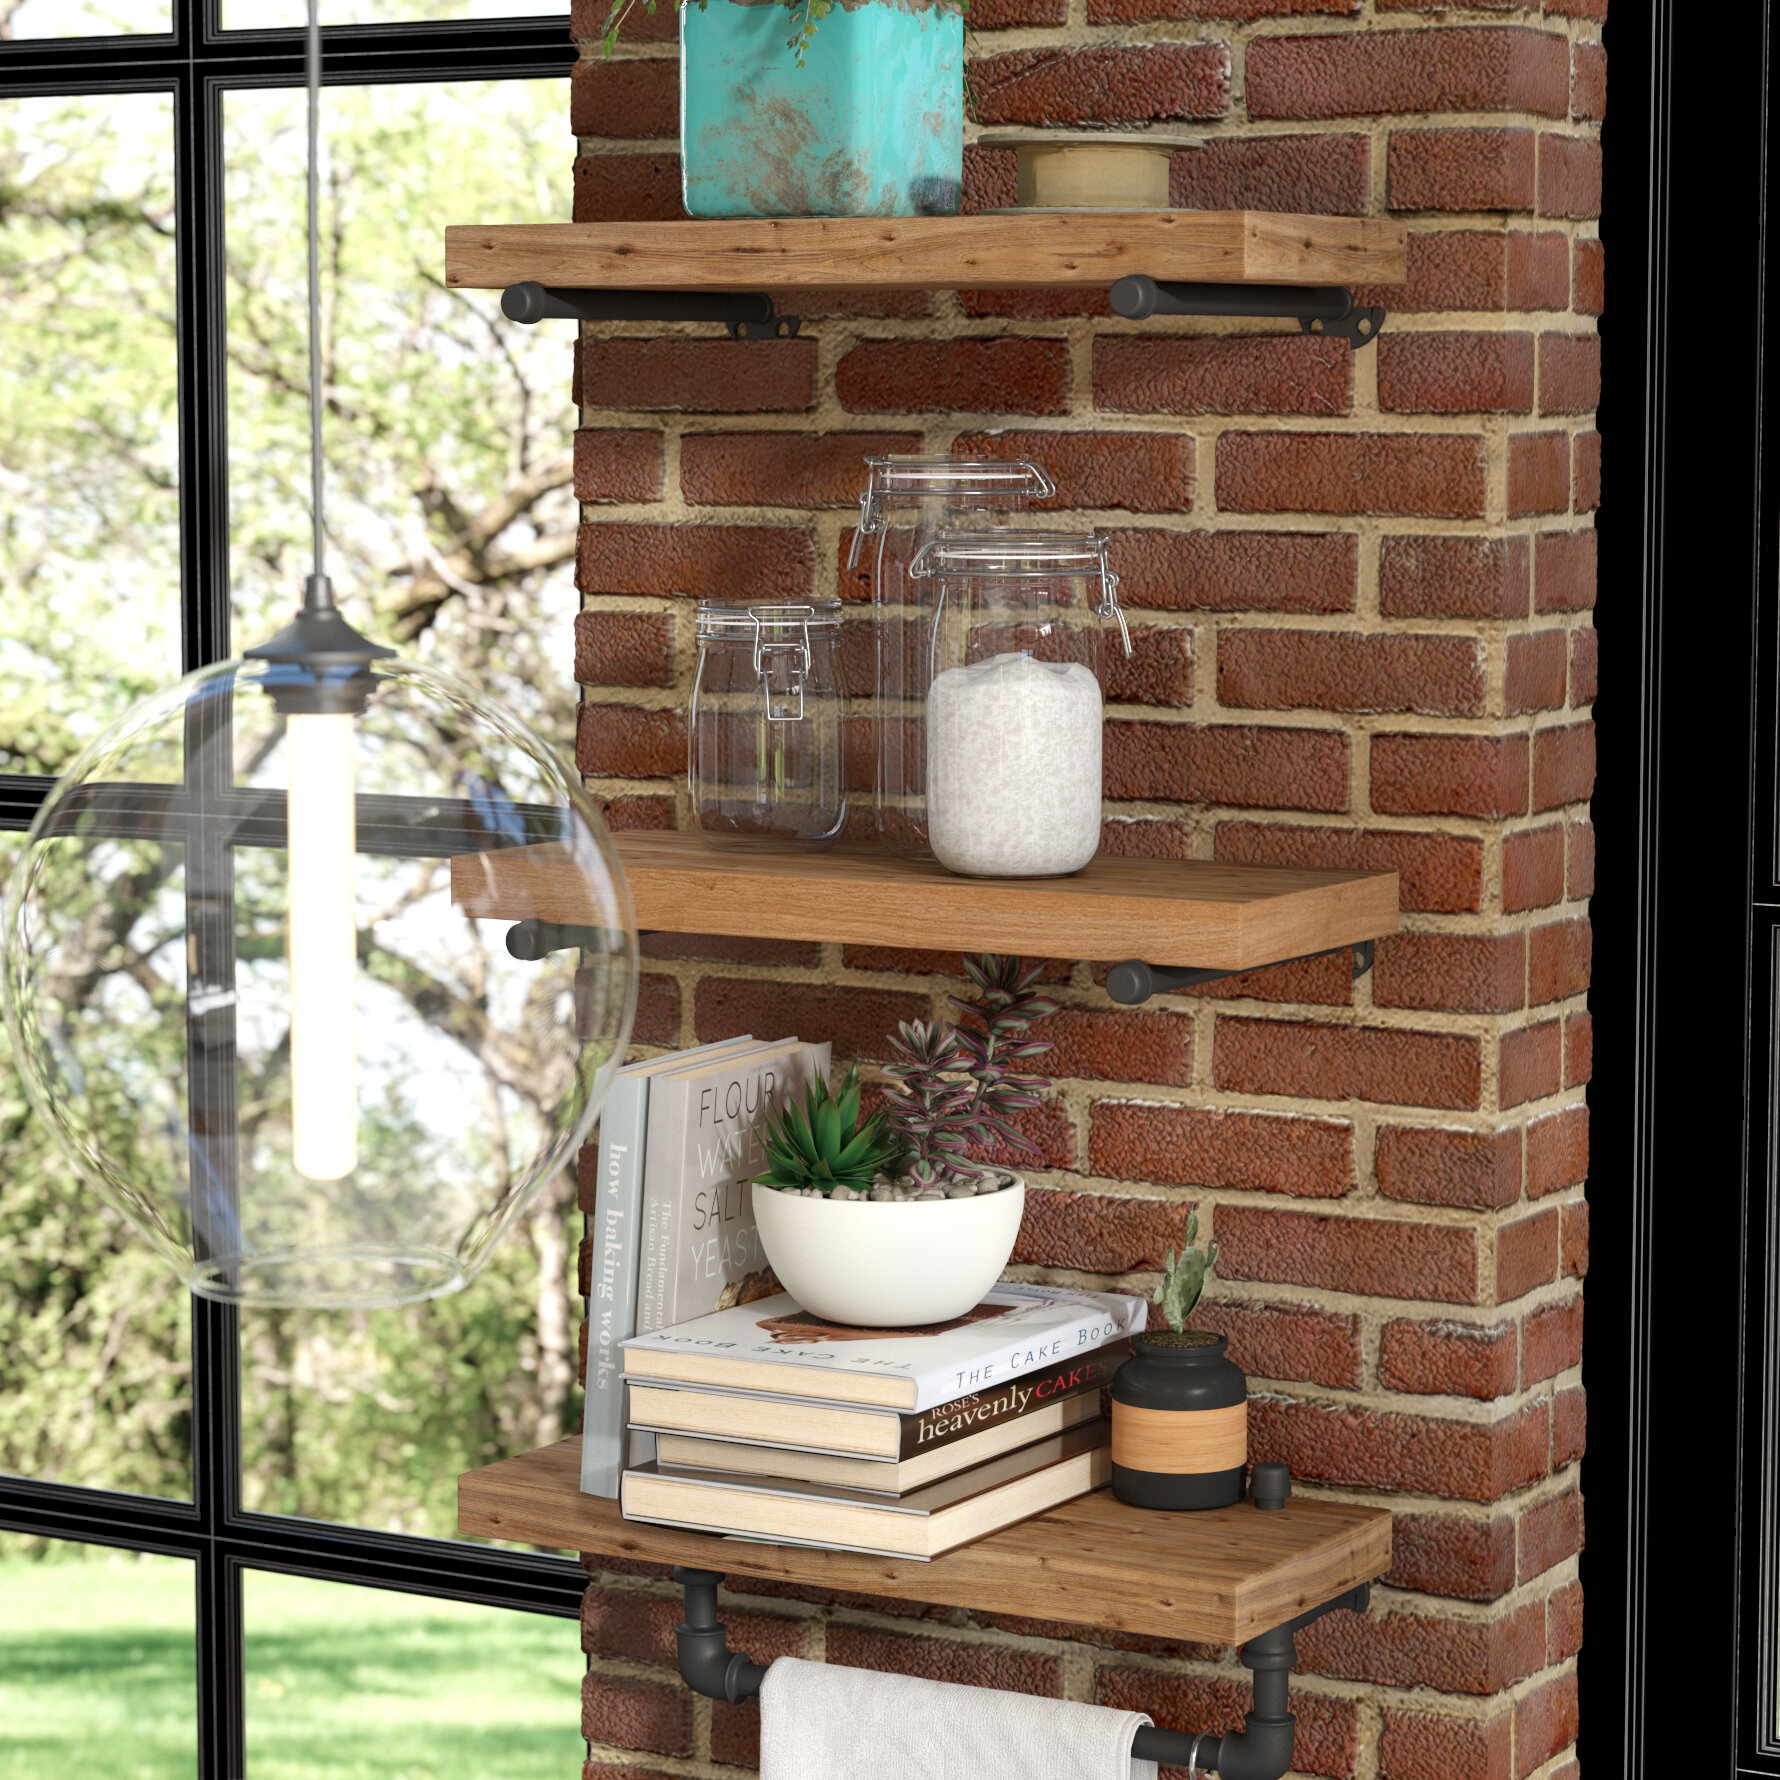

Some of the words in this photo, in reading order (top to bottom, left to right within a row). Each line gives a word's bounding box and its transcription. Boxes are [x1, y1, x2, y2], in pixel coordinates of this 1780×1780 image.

[699, 1072, 775, 1128] FLOUR
[606, 1143, 628, 1199] how
[647, 1198, 660, 1252] Artisan
[660, 1200, 672, 1230] The
[693, 1178, 749, 1231] SALT
[597, 1207, 625, 1302] baking
[645, 1256, 657, 1300] Bread
[643, 1302, 653, 1330] and
[653, 1333, 737, 1349] BOOK
[596, 1310, 616, 1391] works
[751, 1346, 836, 1361] CAKE
[851, 1356, 912, 1370] THE
[956, 1364, 994, 1389] THE
[1011, 1340, 1062, 1369] CAKE
[1077, 1317, 1126, 1346] BOOK
[916, 1385, 1034, 1444] heavenly
[1035, 1359, 1108, 1399] CAKES
[931, 1392, 980, 1420] ROSE'S
